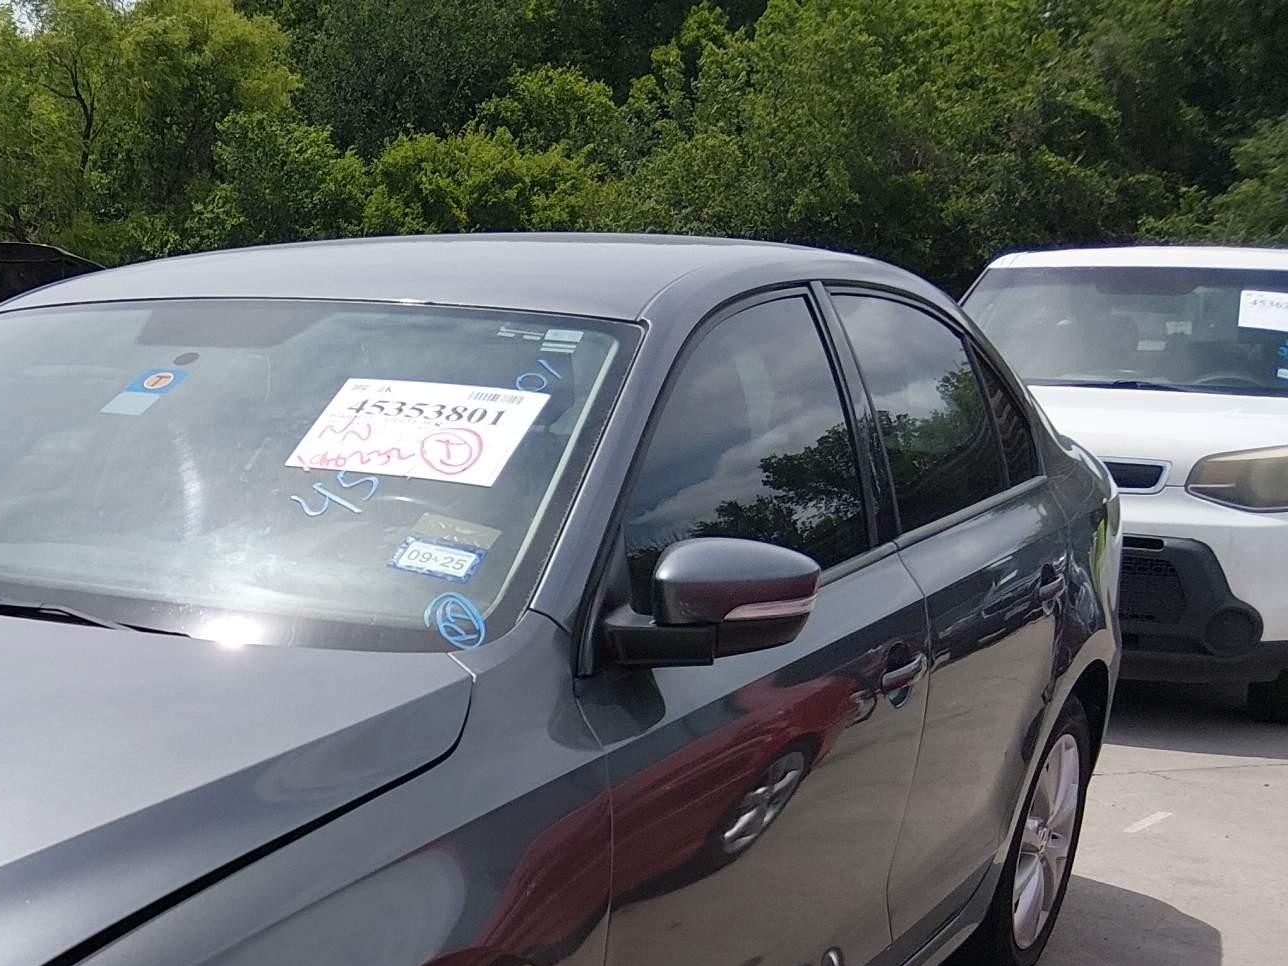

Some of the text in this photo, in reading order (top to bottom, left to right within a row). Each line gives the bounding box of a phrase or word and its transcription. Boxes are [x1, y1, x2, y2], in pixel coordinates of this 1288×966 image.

[347, 398, 507, 427] 45353801
[407, 549, 468, 571] 09 25
